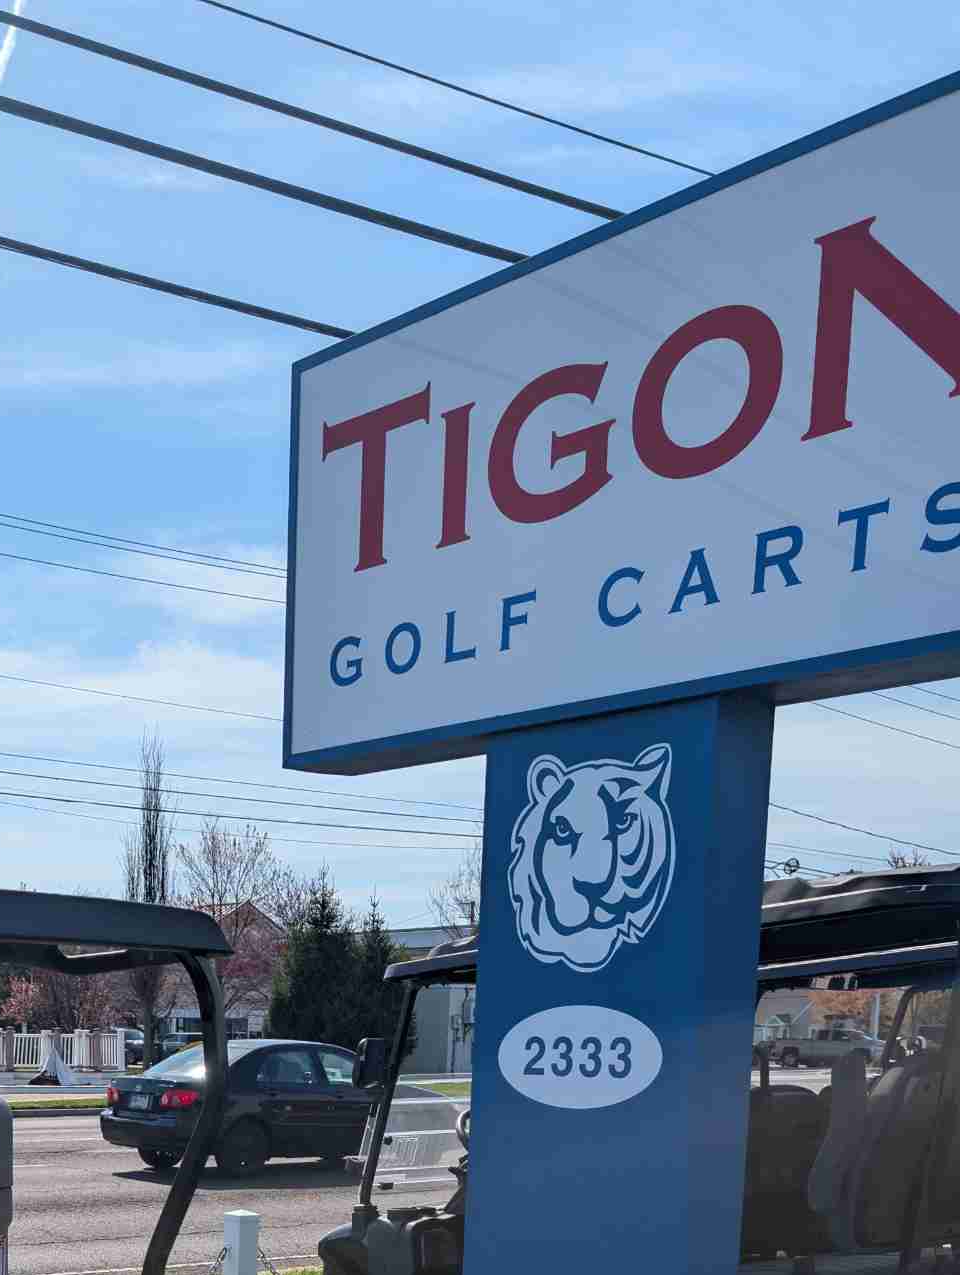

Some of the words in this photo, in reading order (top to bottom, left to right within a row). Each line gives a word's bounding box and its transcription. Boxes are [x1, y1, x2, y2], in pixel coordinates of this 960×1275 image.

[321, 215, 960, 573] TIGON
[329, 588, 537, 687] GOLF
[596, 481, 960, 628] CARTS
[523, 1036, 632, 1079] 2333
